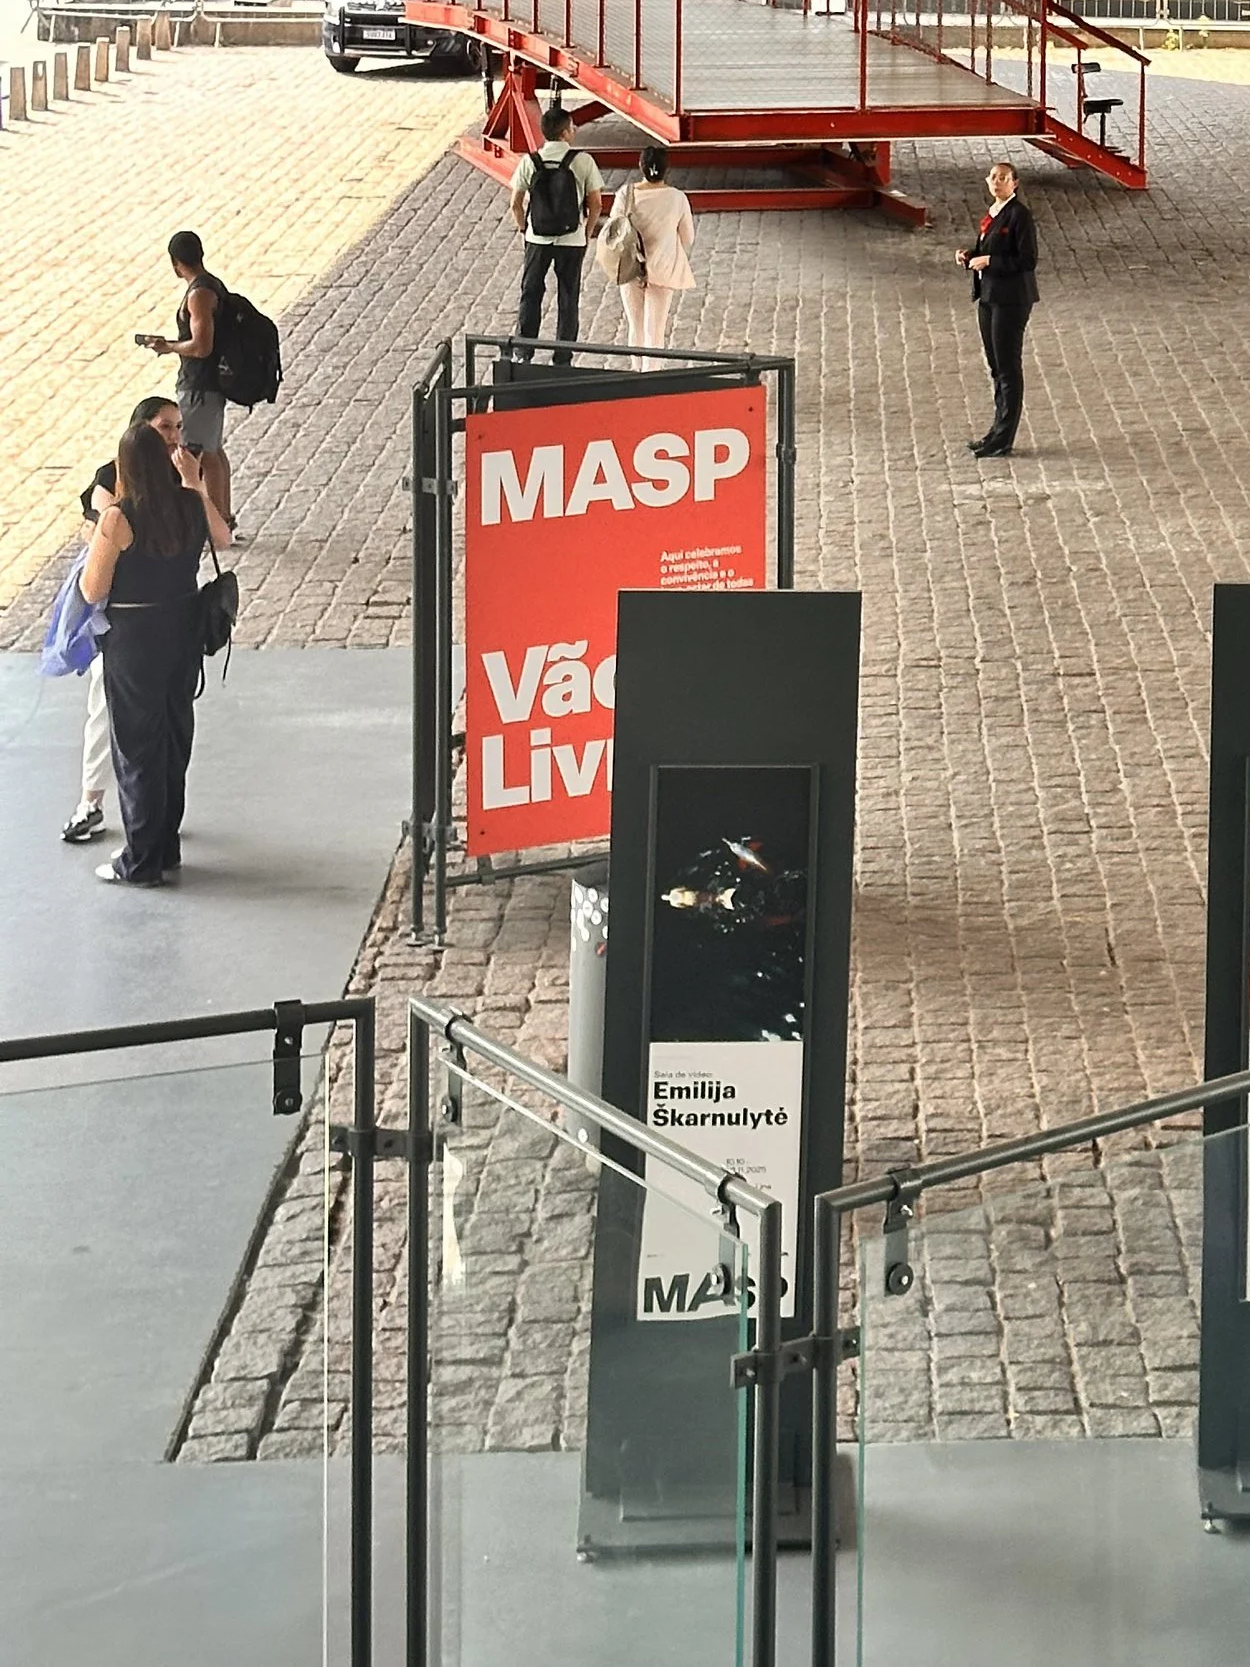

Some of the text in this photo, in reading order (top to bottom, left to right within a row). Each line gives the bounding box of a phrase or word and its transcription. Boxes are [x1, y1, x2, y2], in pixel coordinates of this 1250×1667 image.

[481, 428, 751, 526] MASP
[660, 544, 742, 563] Aqui celebramos
[660, 566, 668, 574] o
[660, 568, 735, 586] convivência e o
[727, 577, 754, 589] todas
[653, 1070, 673, 1079] Sala
[675, 1070, 686, 1079] de
[653, 1080, 736, 1104] Emilija
[652, 1103, 788, 1130] Škarnulytė
